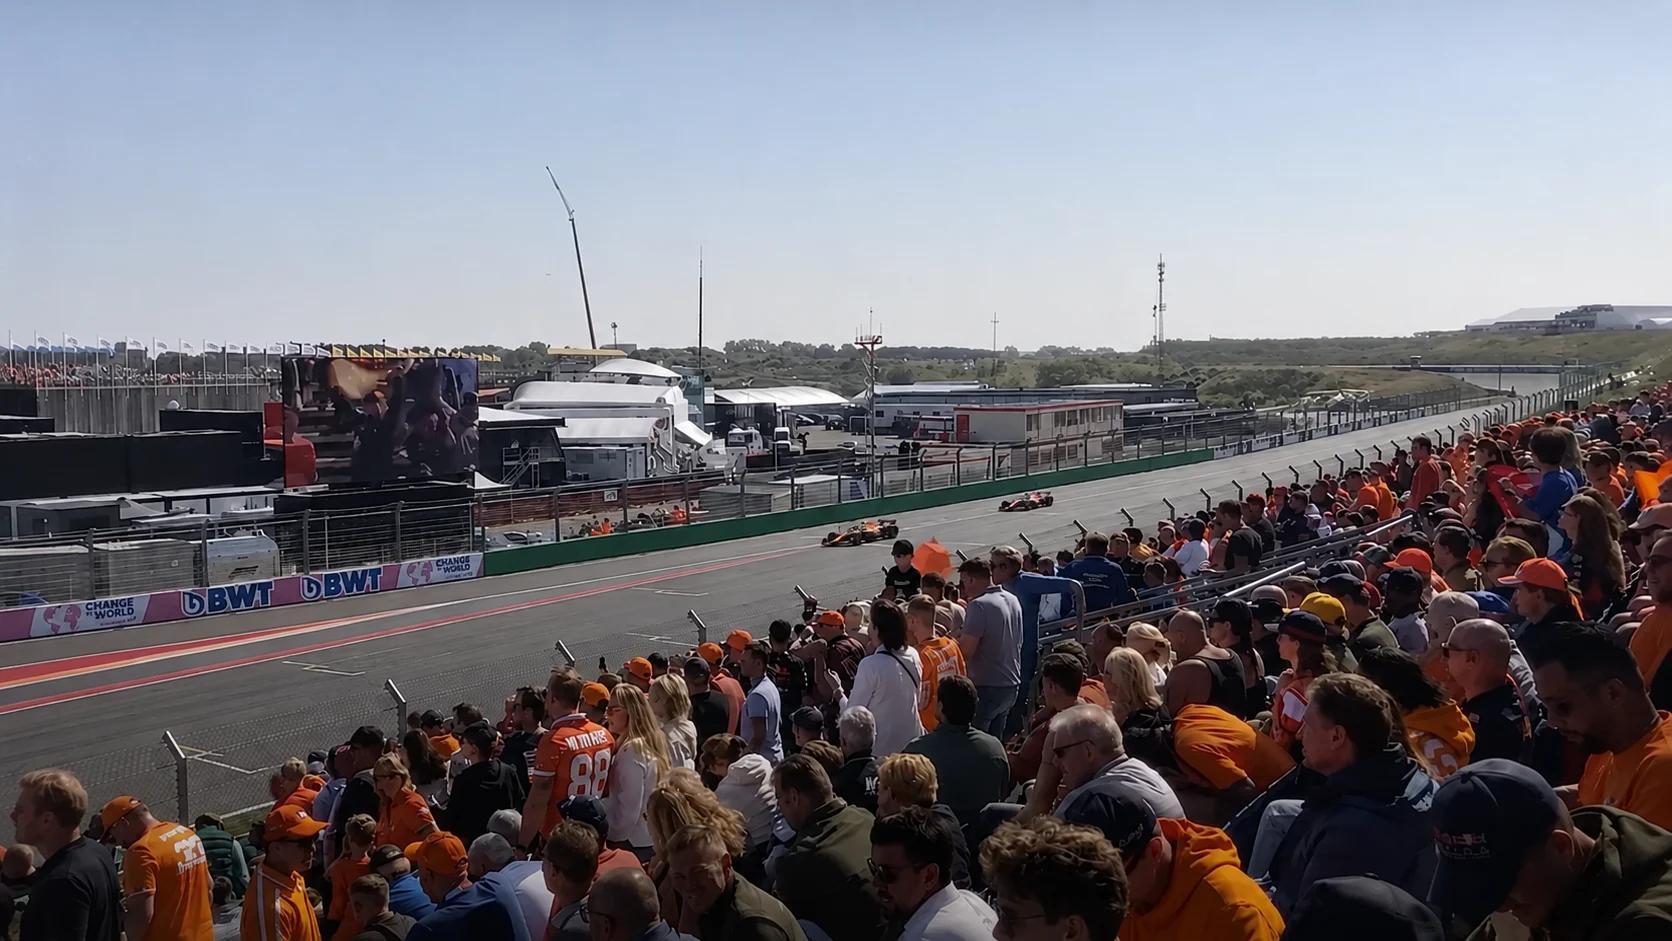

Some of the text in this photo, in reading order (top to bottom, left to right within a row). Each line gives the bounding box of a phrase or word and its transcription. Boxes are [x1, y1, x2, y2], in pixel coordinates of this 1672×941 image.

[206, 580, 274, 614] BWT
[323, 567, 383, 598] BWT
[85, 597, 134, 611] CHANGE
[94, 607, 135, 620] WORLD
[567, 747, 611, 800] 88
